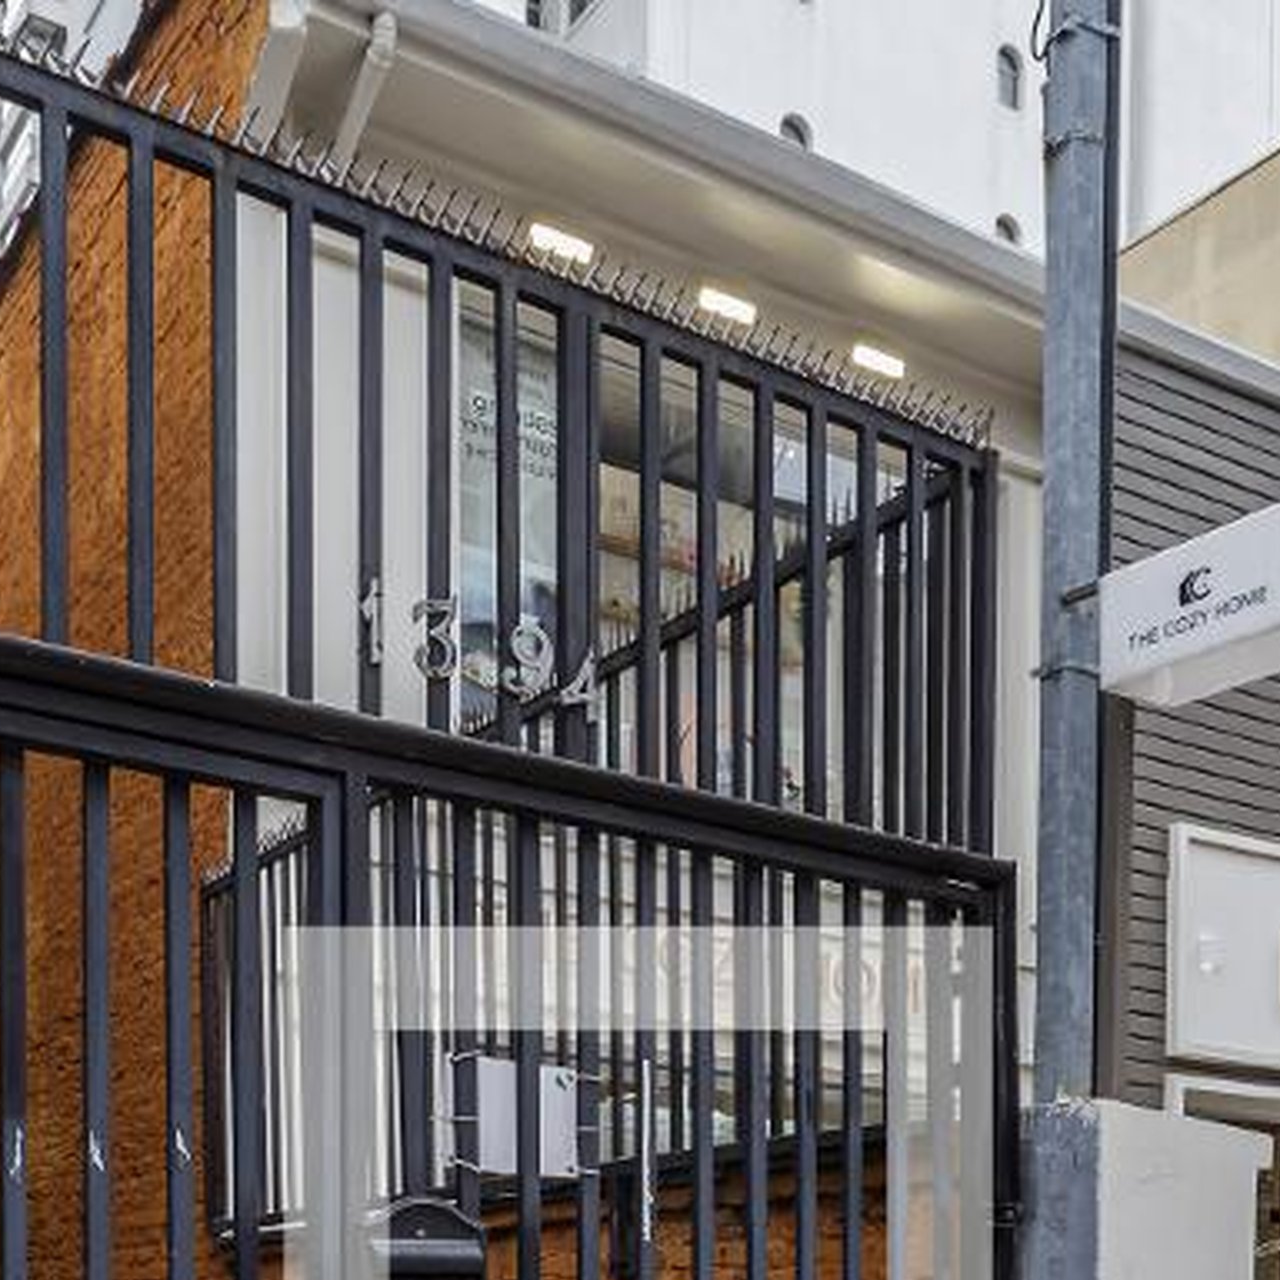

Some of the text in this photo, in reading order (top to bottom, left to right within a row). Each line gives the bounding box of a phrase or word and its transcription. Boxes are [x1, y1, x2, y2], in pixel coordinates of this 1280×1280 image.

[1128, 586, 1269, 651] THE COZY HOME
